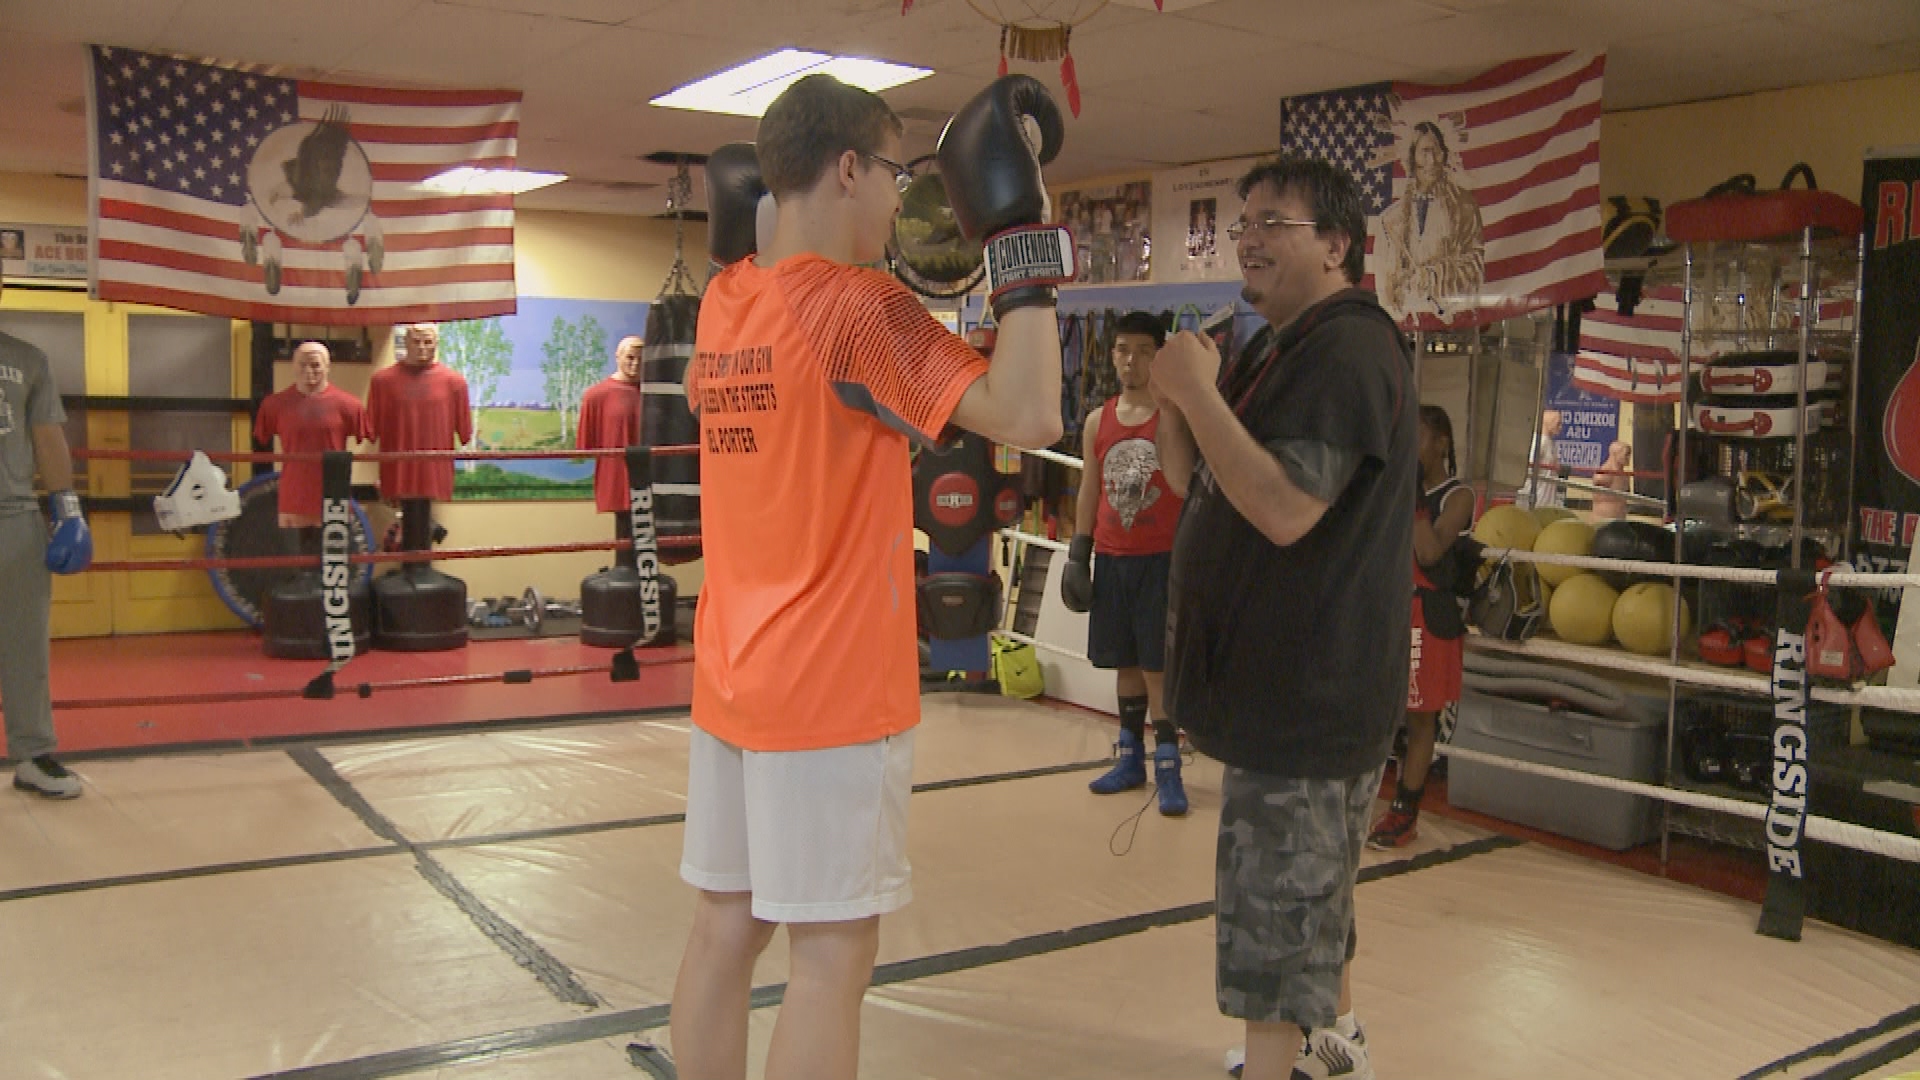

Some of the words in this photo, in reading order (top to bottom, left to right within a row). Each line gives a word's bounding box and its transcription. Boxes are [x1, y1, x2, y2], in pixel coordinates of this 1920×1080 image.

[999, 231, 1060, 271] CONTENDER
[740, 347, 755, 375] OUR
[755, 345, 773, 374] GYM
[725, 385, 742, 413] THE
[741, 383, 777, 412] STREETS
[718, 427, 758, 454] PORTER
[1859, 507, 1897, 546] THE
[322, 497, 356, 662] INGSIDE
[1765, 627, 1808, 879] RINGSIDE
